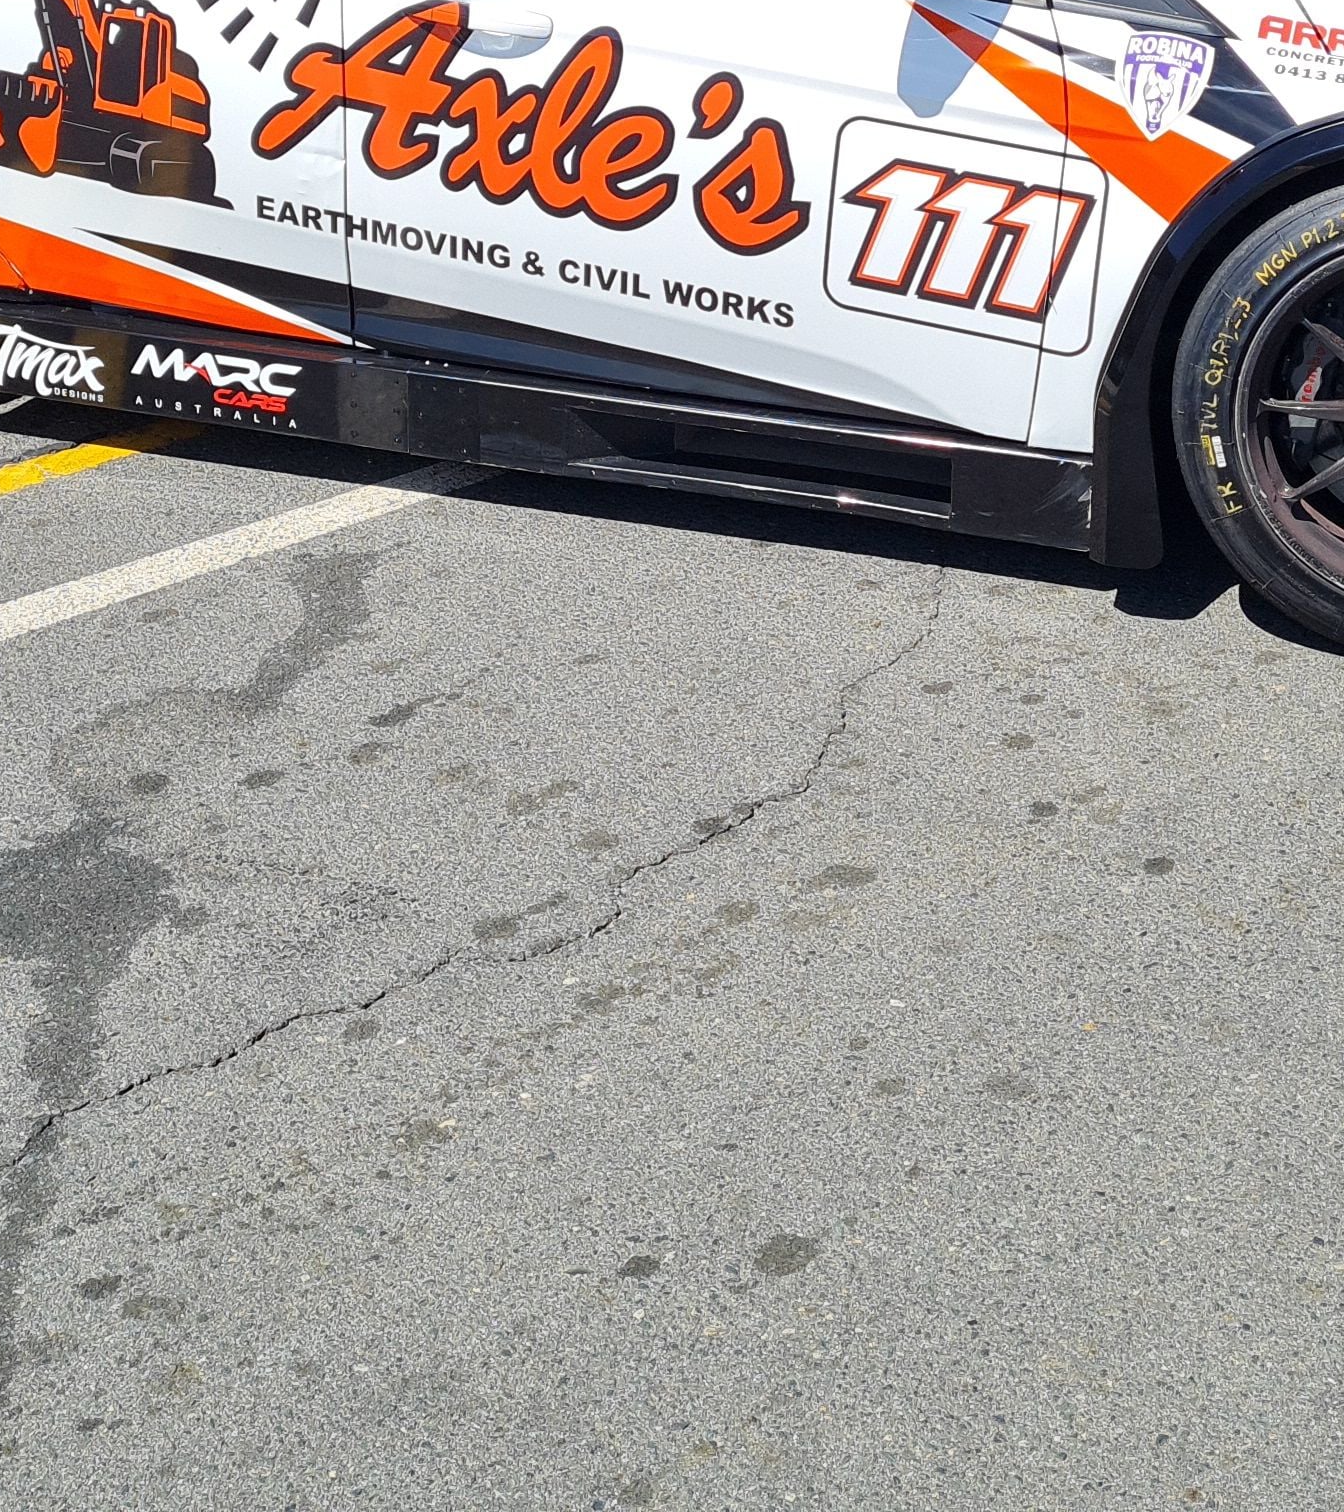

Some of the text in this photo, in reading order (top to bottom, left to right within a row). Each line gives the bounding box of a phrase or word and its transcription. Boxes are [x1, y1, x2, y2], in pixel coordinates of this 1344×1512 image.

[1128, 36, 1204, 65] ROBINA
[1275, 64, 1327, 81] 0413
[843, 157, 1096, 323] 111
[256, 194, 795, 329] EARTHMOVING & CIVIL WORKS
[1255, 240, 1299, 287] MGN
[130, 344, 302, 396] MARC
[54, 387, 105, 403] DESIGNS
[134, 394, 298, 430] AUSTRALIA
[213, 388, 288, 414] CARS
[1217, 480, 1244, 515] FR
